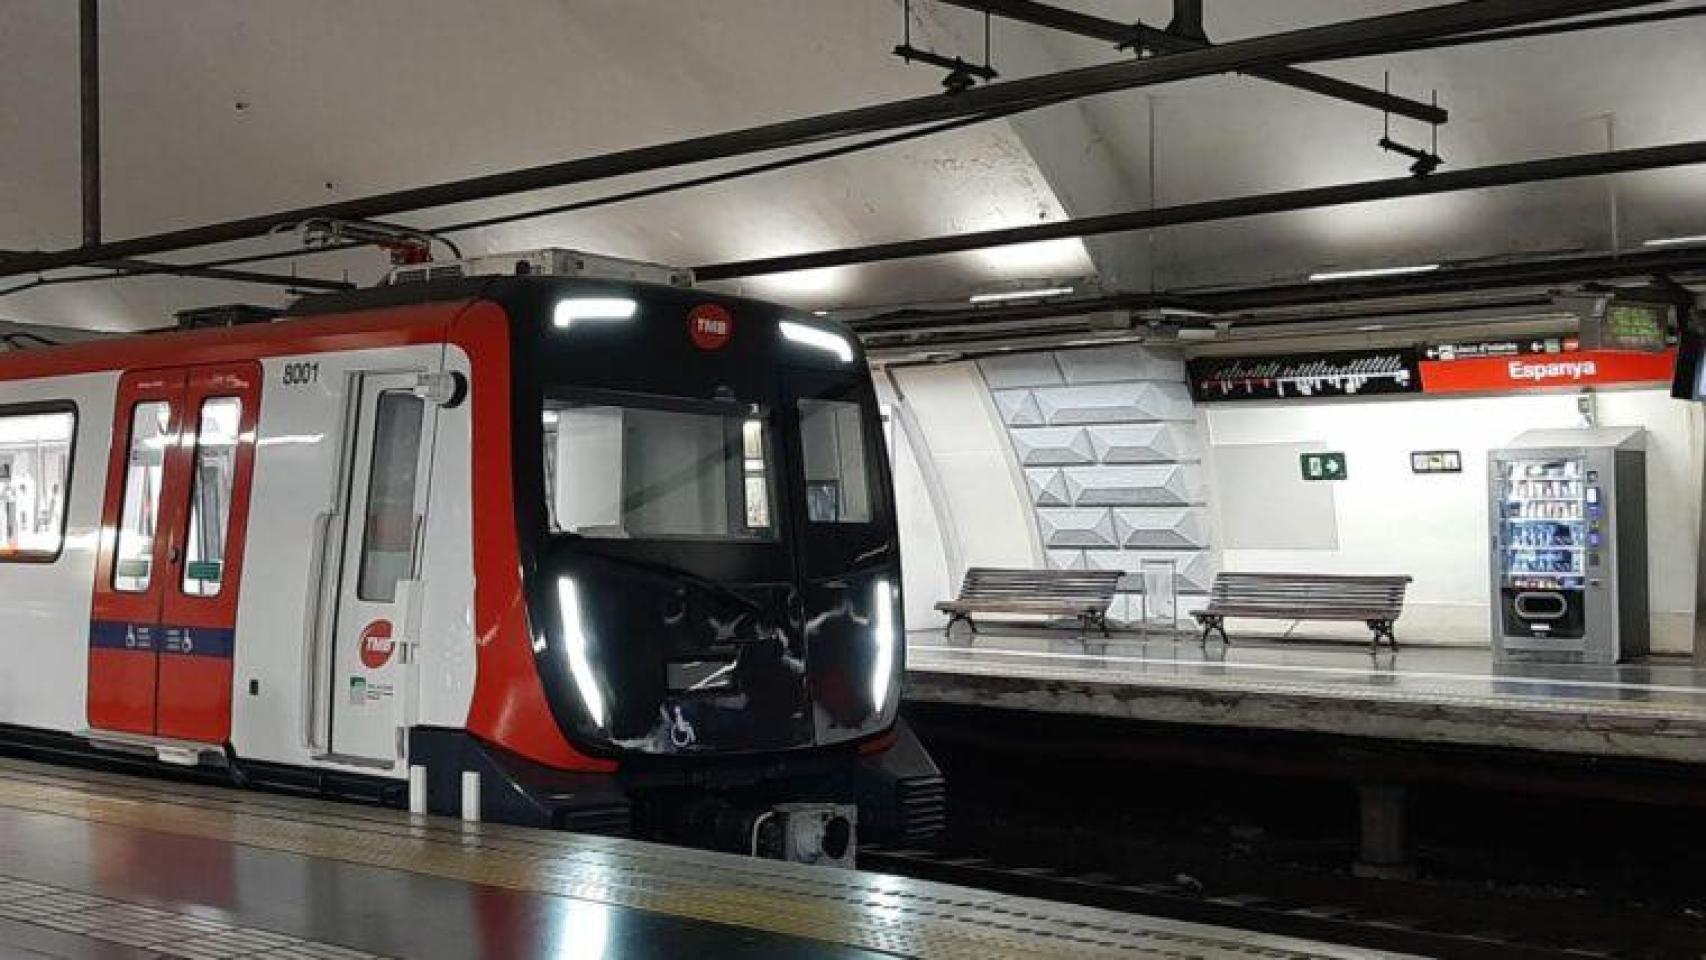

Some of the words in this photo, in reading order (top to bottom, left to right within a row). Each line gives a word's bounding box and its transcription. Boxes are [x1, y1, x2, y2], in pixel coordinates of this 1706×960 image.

[697, 318, 727, 335] TMB
[282, 361, 319, 385] 8001
[1508, 360, 1596, 380] Espanya
